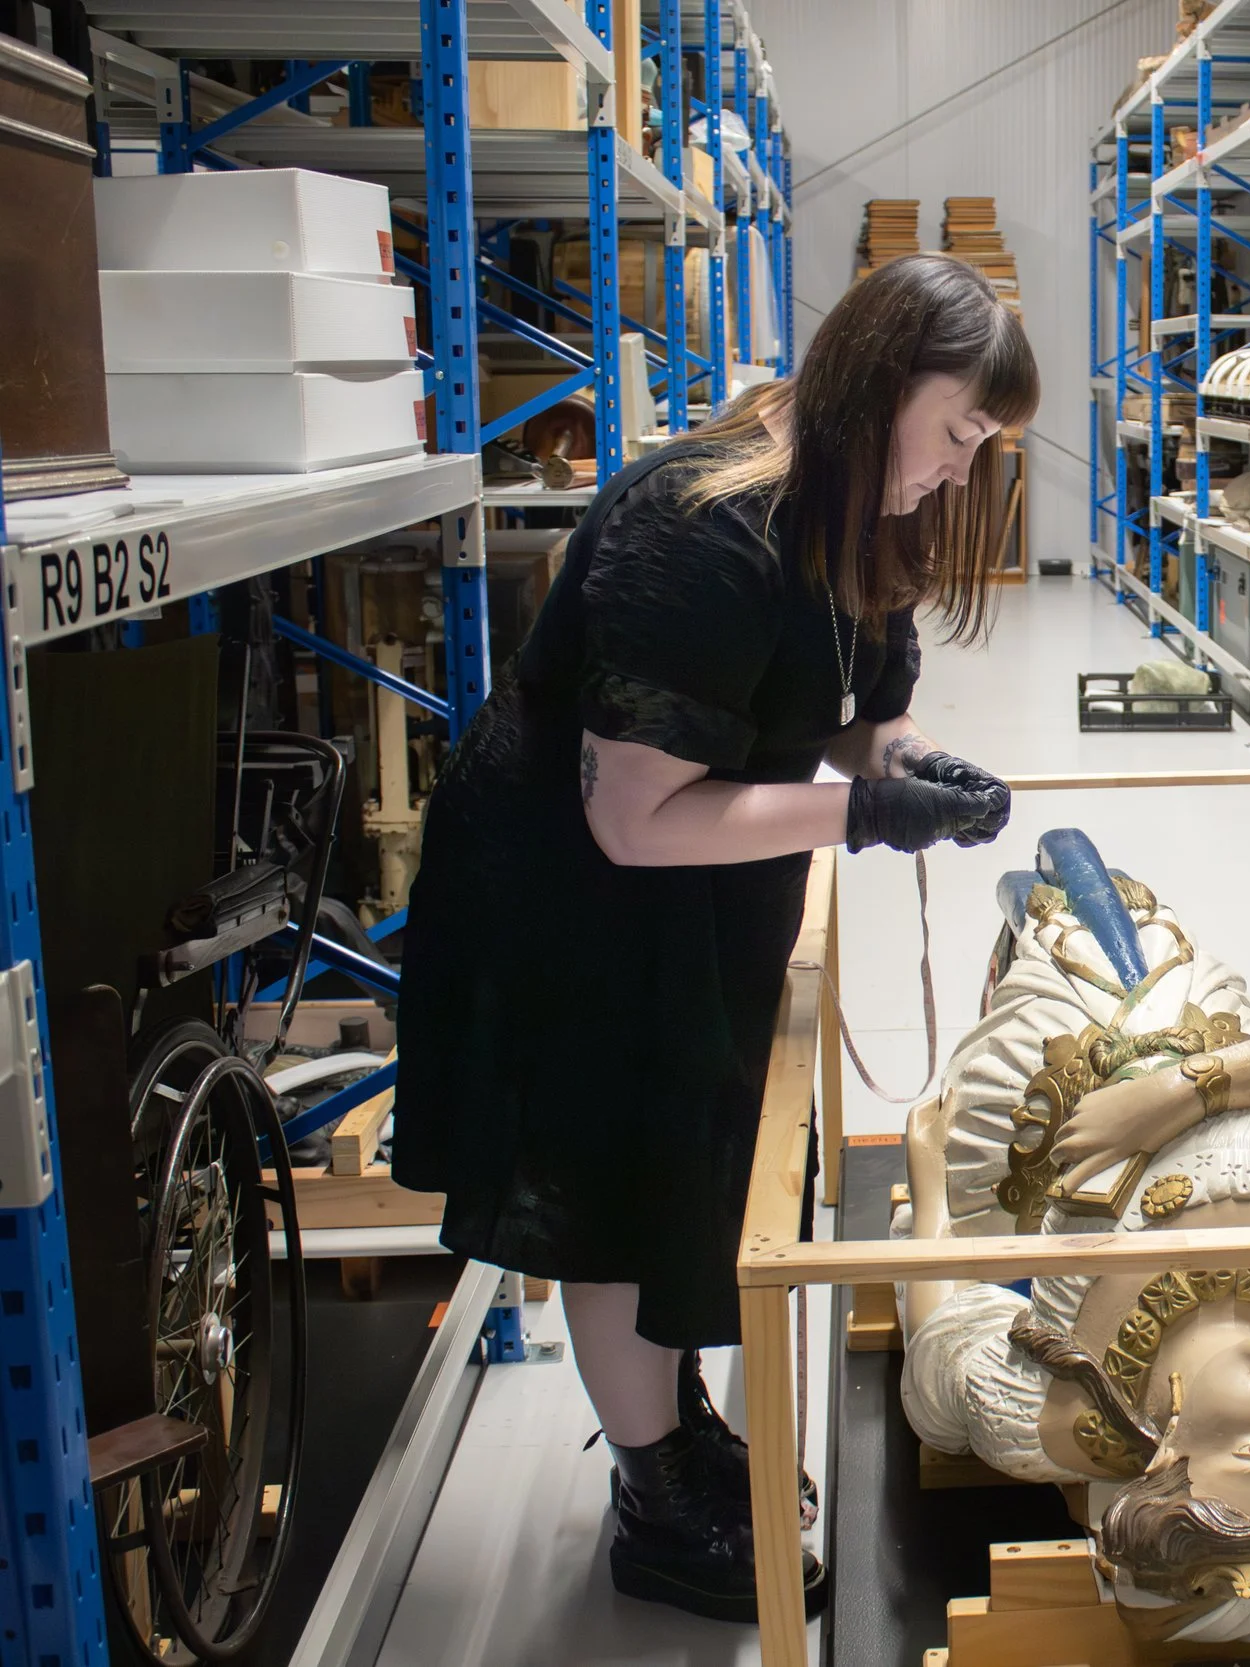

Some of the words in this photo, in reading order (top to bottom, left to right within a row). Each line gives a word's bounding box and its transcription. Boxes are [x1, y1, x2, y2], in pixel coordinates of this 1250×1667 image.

[40, 548, 83, 631] R9
[93, 539, 130, 617] B2
[139, 531, 170, 603] S2
